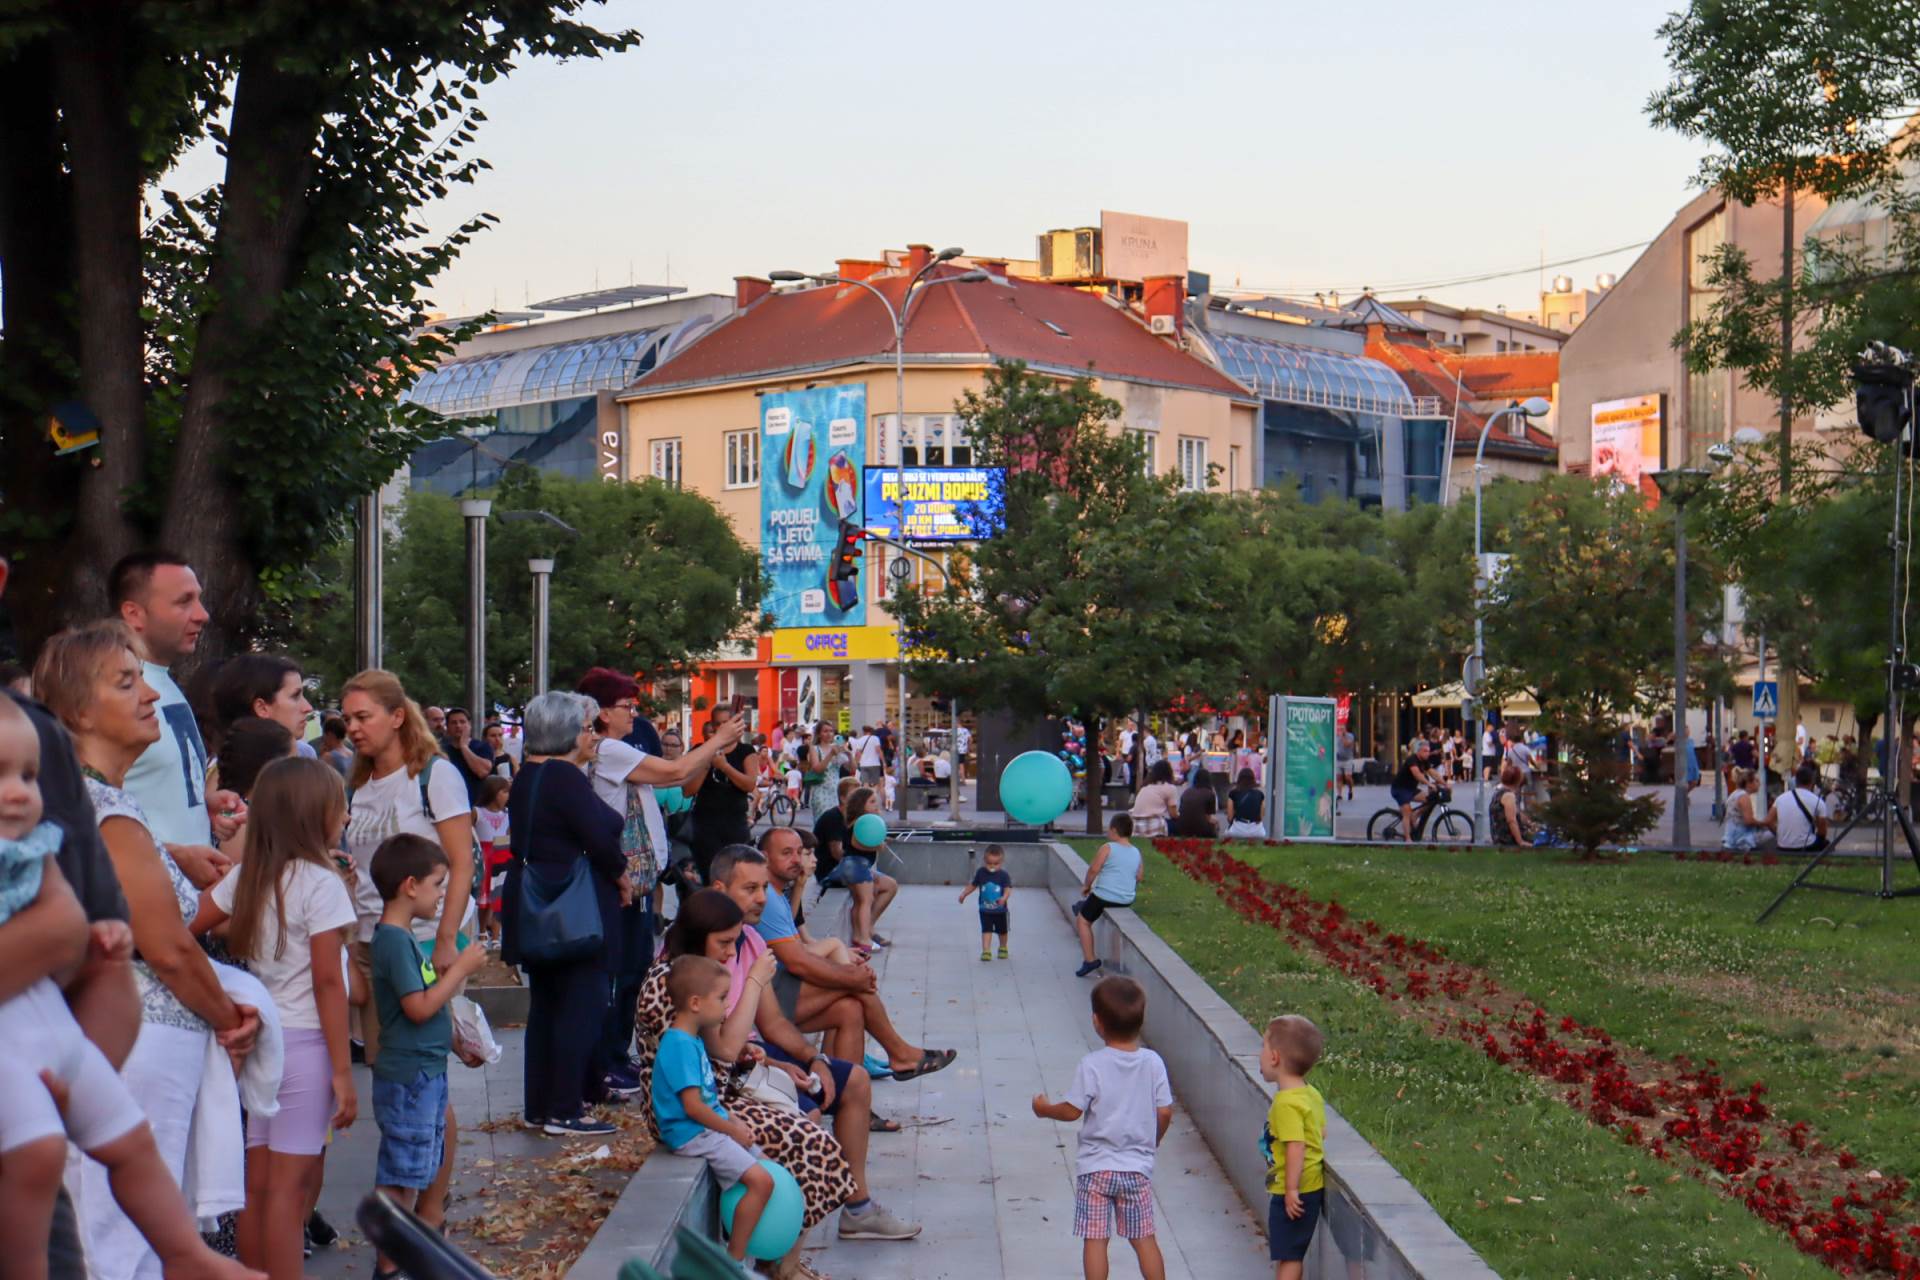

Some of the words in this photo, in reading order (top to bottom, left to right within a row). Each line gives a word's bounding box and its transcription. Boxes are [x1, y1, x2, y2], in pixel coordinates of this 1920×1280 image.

[1121, 236, 1158, 249] KRUNA
[943, 482, 989, 501] BONUS
[771, 508, 820, 527] PODIJELI
[778, 528, 813, 544] LJETO
[768, 547, 784, 563] SA
[785, 544, 823, 562] SVIMA
[805, 633, 848, 650] OFFICE
